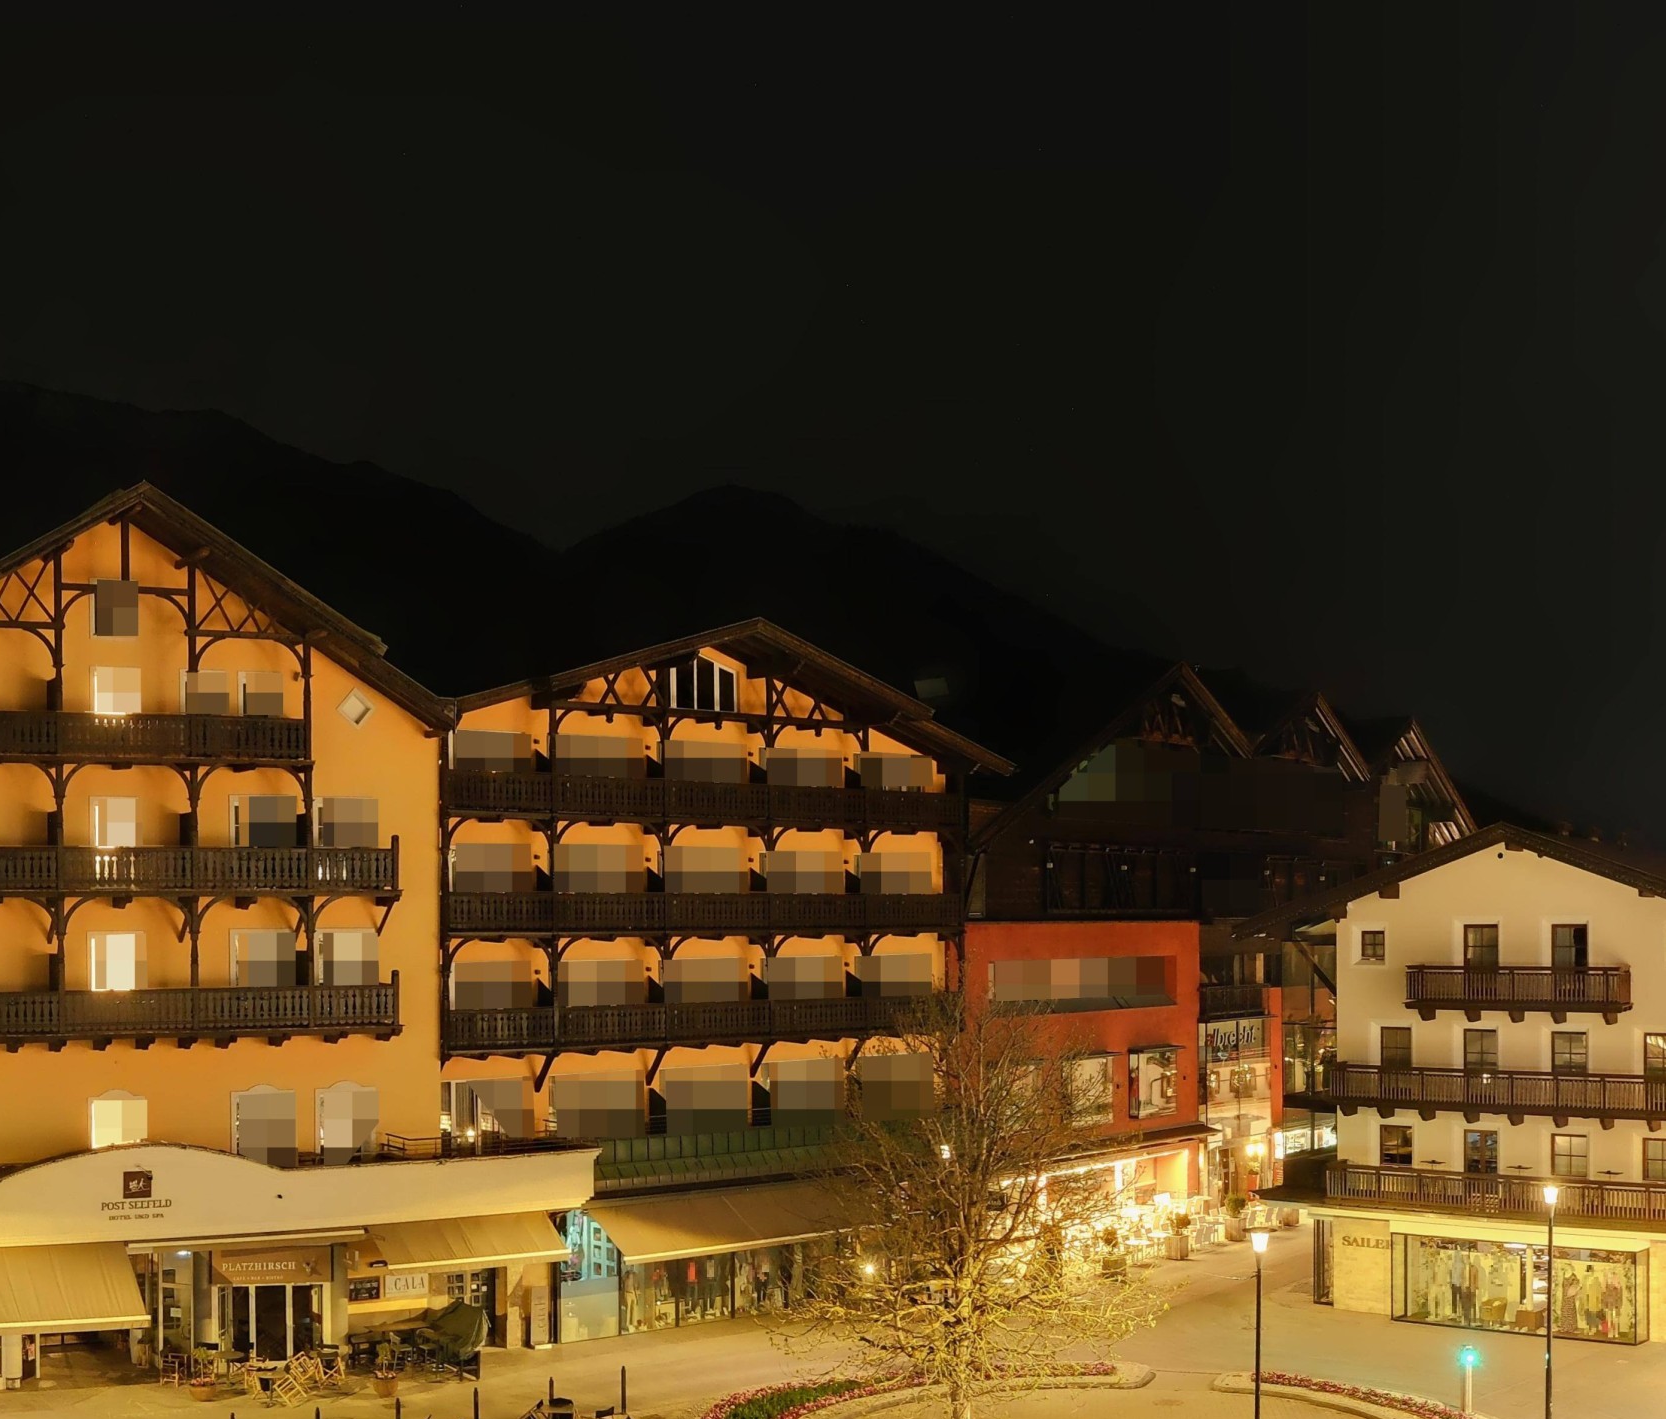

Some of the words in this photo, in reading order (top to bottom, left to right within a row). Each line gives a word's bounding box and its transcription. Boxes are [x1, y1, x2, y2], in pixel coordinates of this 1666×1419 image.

[101, 1201, 126, 1211] POST
[129, 1199, 172, 1210] SEEFELD
[222, 1261, 296, 1272] PLATZHIRSCH
